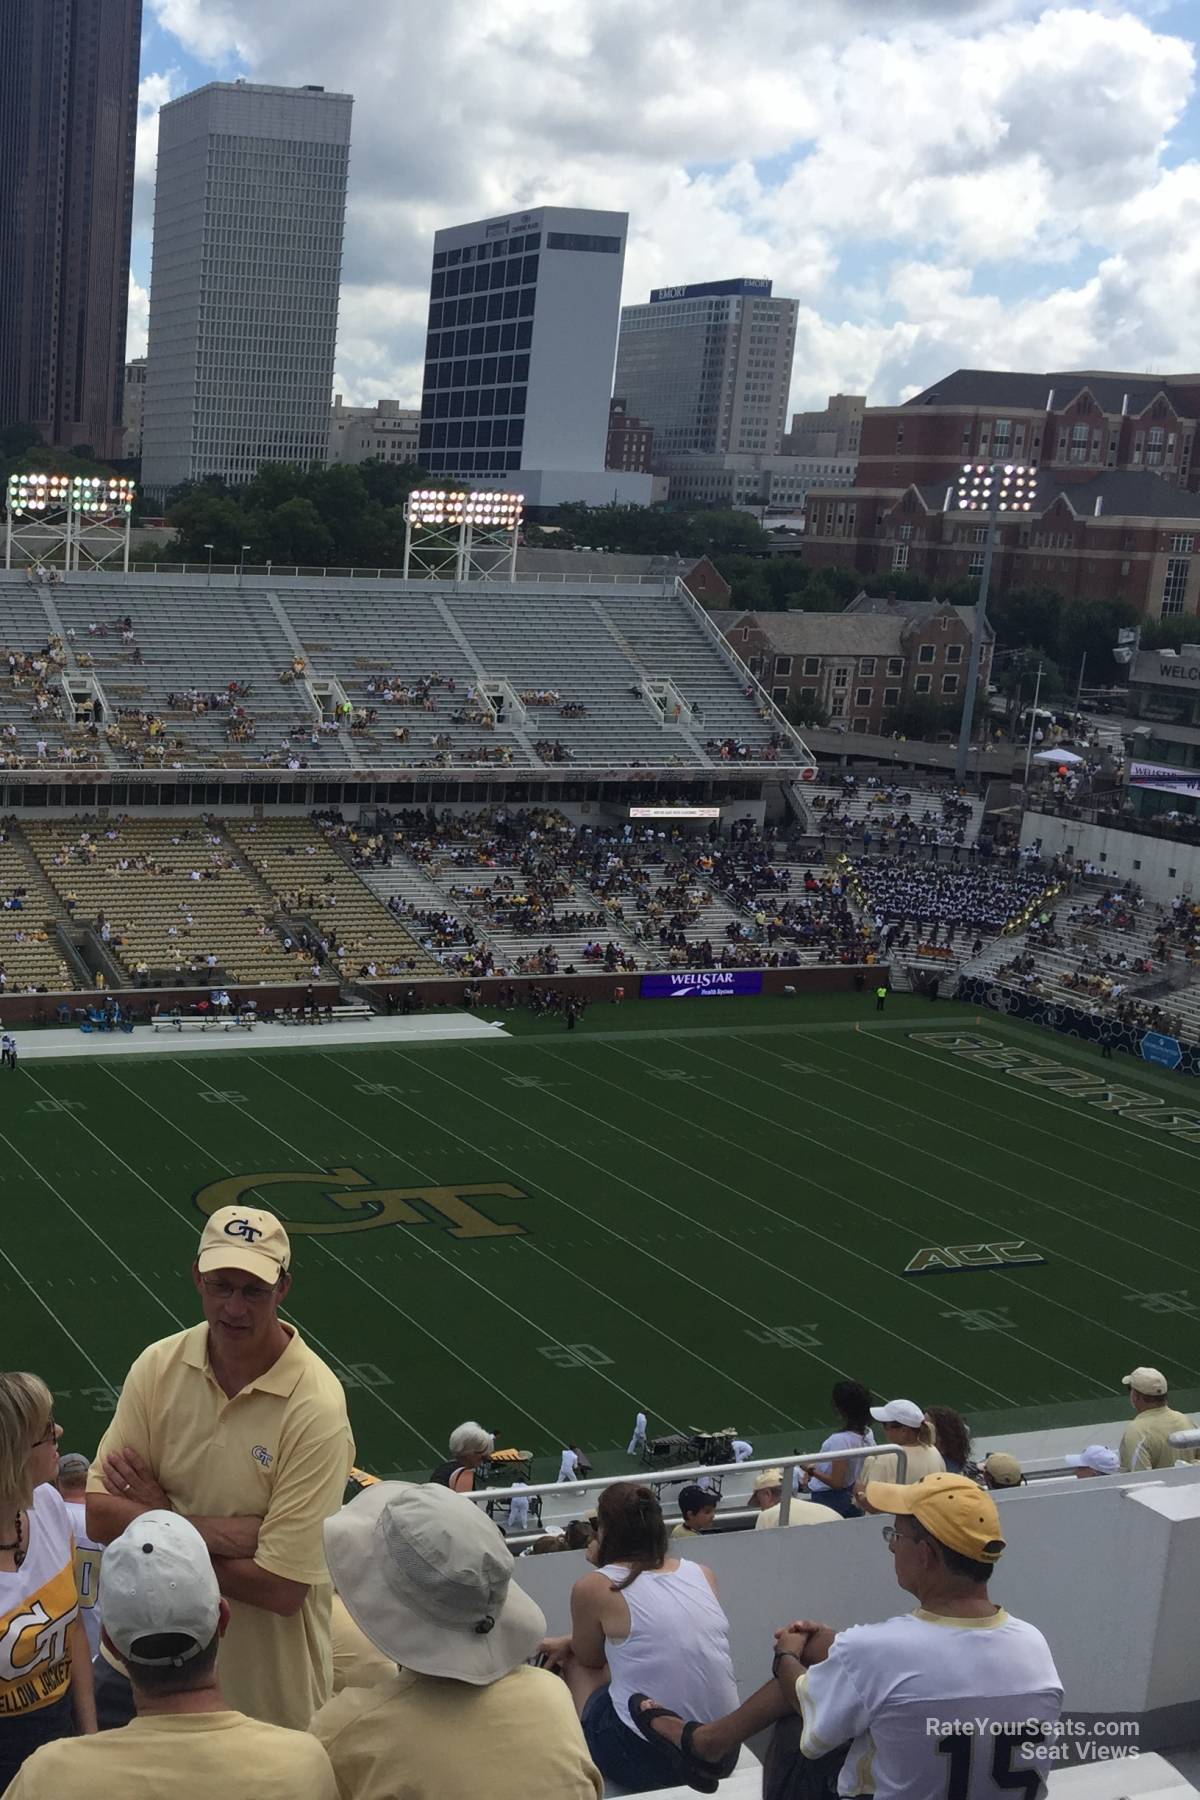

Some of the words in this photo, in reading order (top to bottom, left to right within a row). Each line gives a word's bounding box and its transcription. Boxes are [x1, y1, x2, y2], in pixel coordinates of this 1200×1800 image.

[658, 287, 687, 300] EMORY
[743, 279, 770, 289] EMORY
[1160, 663, 1200, 681] WELC
[671, 973, 734, 987] WELLSTAR
[191, 1167, 531, 1240] GT
[224, 1219, 263, 1243] GT
[903, 1240, 1046, 1273] ACC
[938, 1307, 1019, 1332] 30
[742, 1324, 824, 1349] 40
[536, 1342, 616, 1369] 50
[338, 1363, 396, 1389] 0
[80, 1385, 119, 1413] 3
[251, 1444, 274, 1469] GT
